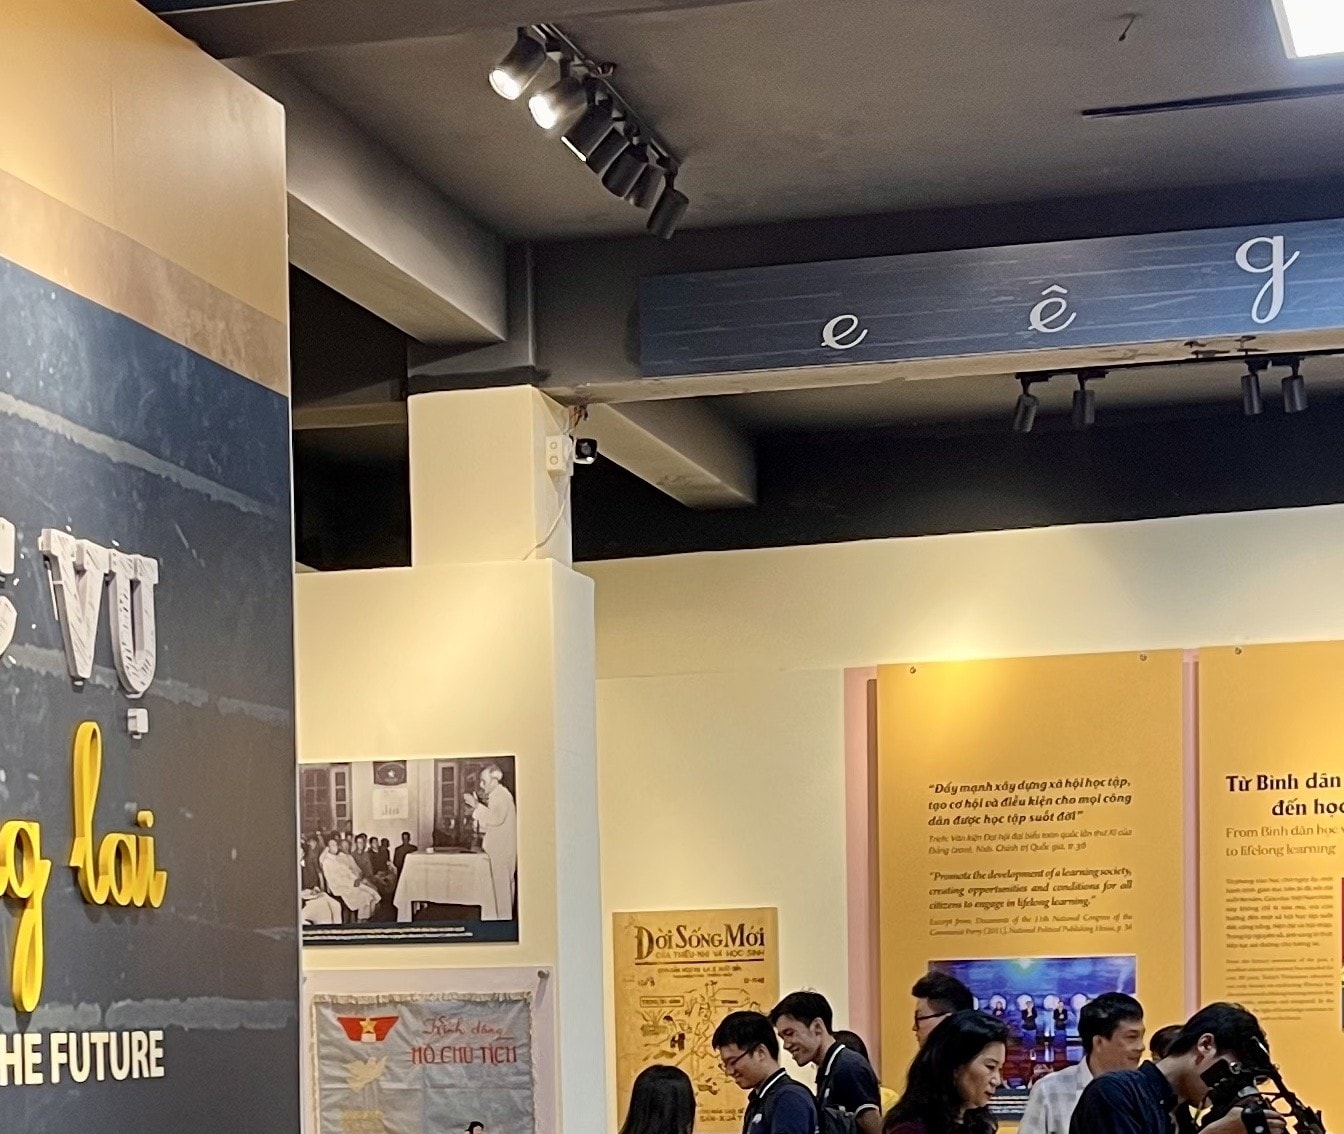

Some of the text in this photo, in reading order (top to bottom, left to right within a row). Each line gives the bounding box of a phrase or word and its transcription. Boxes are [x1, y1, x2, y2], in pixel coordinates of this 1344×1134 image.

[821, 233, 1301, 352] e ê g
[40, 527, 159, 737] VỤ
[1225, 775, 1253, 792] Từ
[1306, 772, 1342, 788] dân
[69, 720, 169, 909] lai
[1272, 798, 1306, 816] đến
[1226, 827, 1258, 838] From
[1226, 847, 1238, 856] to
[50, 1030, 166, 1084] FUTURE
